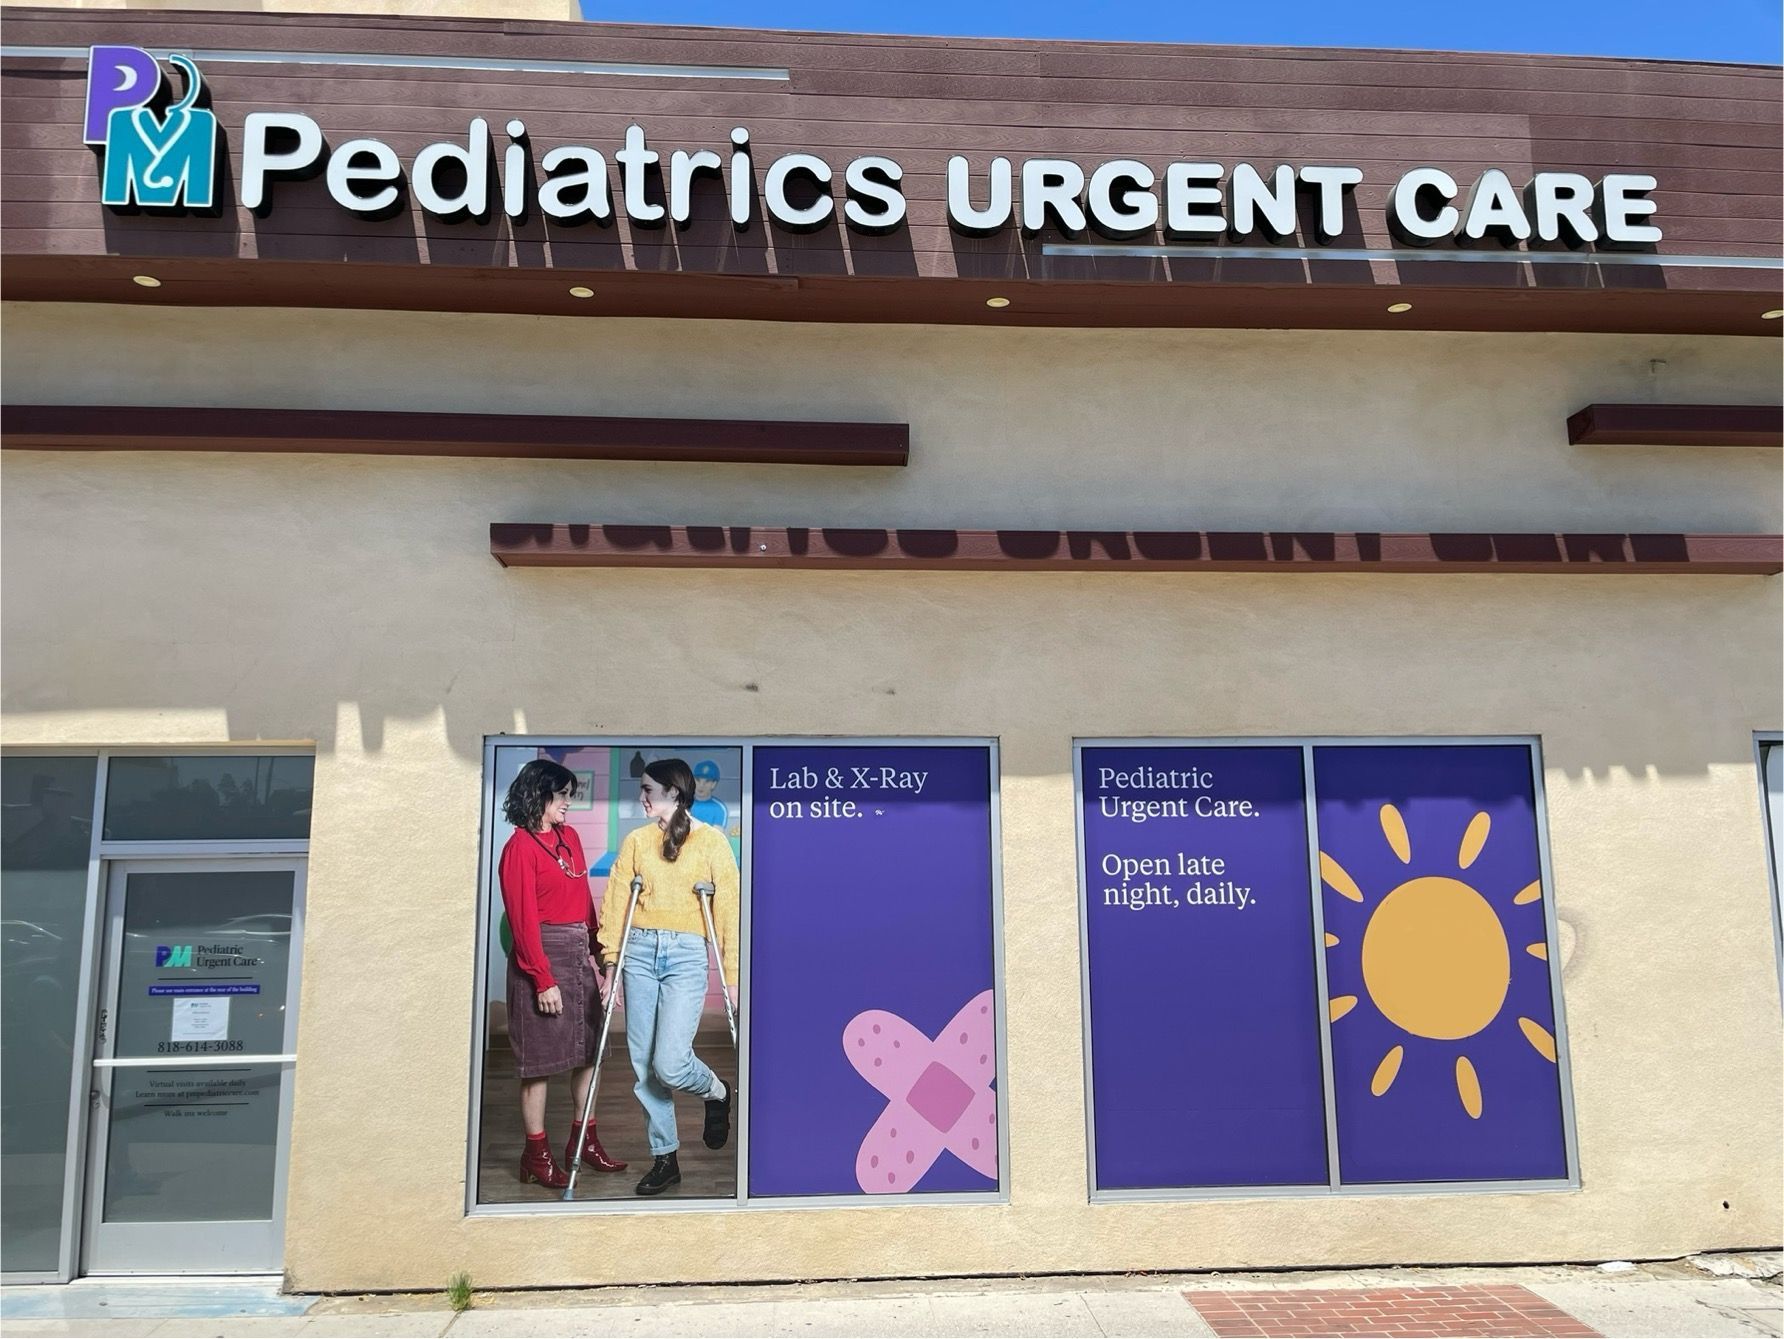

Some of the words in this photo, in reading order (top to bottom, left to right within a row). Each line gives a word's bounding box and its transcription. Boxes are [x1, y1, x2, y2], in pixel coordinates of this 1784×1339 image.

[240, 111, 906, 231] Pediatrics
[947, 156, 1363, 239] URGENT
[1394, 167, 1663, 243] CARE
[770, 766, 818, 789] Lab
[825, 767, 844, 789] &
[850, 767, 928, 794] X-Ray
[1099, 766, 1214, 789] Pediatric
[769, 800, 803, 818] on
[810, 796, 863, 818] site.
[1099, 796, 1189, 823] Urgent
[1195, 796, 1260, 818] Care.
[1102, 853, 1171, 881] Open
[1178, 852, 1225, 876] late
[1103, 882, 1180, 911] night,
[1186, 881, 1256, 910] daily.
[197, 945, 244, 955] Pediatric
[196, 957, 231, 969] Urgent
[233, 957, 258, 967] Care
[157, 1040, 244, 1053] 818-614-3088
